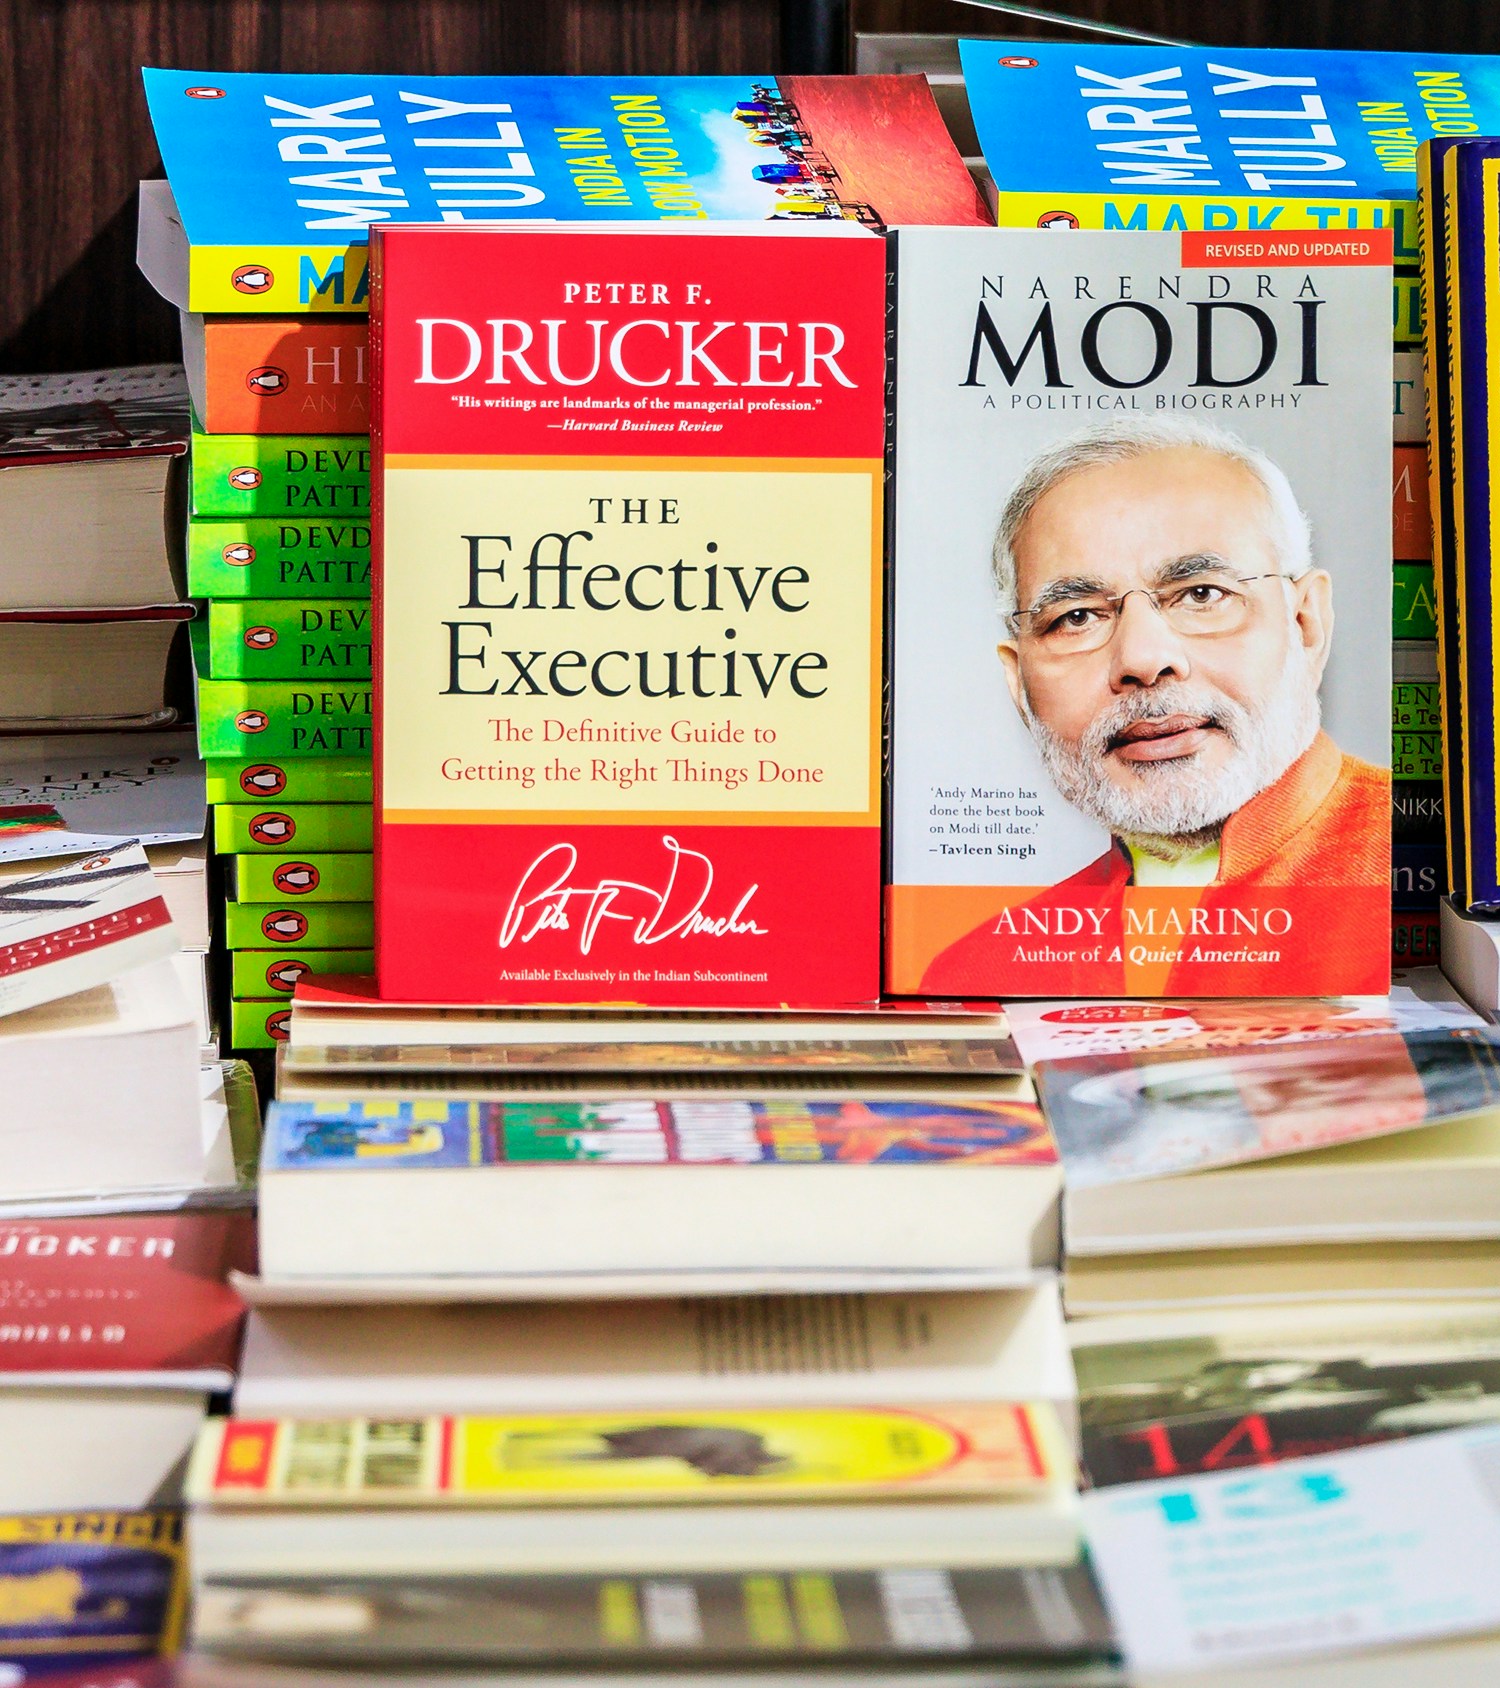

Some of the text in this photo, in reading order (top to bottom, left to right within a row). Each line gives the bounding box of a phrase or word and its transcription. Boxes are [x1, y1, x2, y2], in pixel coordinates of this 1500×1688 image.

[610, 95, 687, 176] MOTION
[1075, 65, 1221, 186] MARK
[1207, 62, 1358, 191] TULLY
[1357, 102, 1418, 172] INDIA IN
[264, 94, 409, 229] MARK
[399, 90, 556, 223] TULLY
[554, 128, 633, 206] INDIA IN
[1206, 243, 1370, 257] REVISED AND UPDATED
[564, 283, 711, 304] PETER F.
[981, 274, 1319, 300] NARENDRA
[414, 319, 858, 388] DRUCKER
[958, 300, 1329, 388] MODI
[452, 395, 822, 413] “His writings are landmarks of the managerial profession.”
[984, 394, 1301, 409] A POLITICAL BIOGRAPHY
[547, 418, 723, 431] —Harvard Business Review
[285, 484, 371, 507] PATT
[589, 498, 679, 524] THE
[459, 531, 809, 612] Effective
[439, 622, 827, 698] Executive
[488, 719, 776, 743] The Definitive Guide to
[442, 758, 823, 790] Getting the Right Things Done
[931, 787, 1037, 802] ‘Andy Marino has
[930, 803, 1044, 816] done the best book
[950, 822, 979, 833] Modi
[985, 822, 1001, 833] till
[1006, 822, 1038, 834] date.’
[929, 843, 1035, 859] –Tavleen Singh
[992, 907, 1293, 936] ANDY MARINO
[1012, 946, 1280, 965] Author of A Quiet American
[500, 968, 768, 984] Available Exclusively in the Indian Subcontinent
